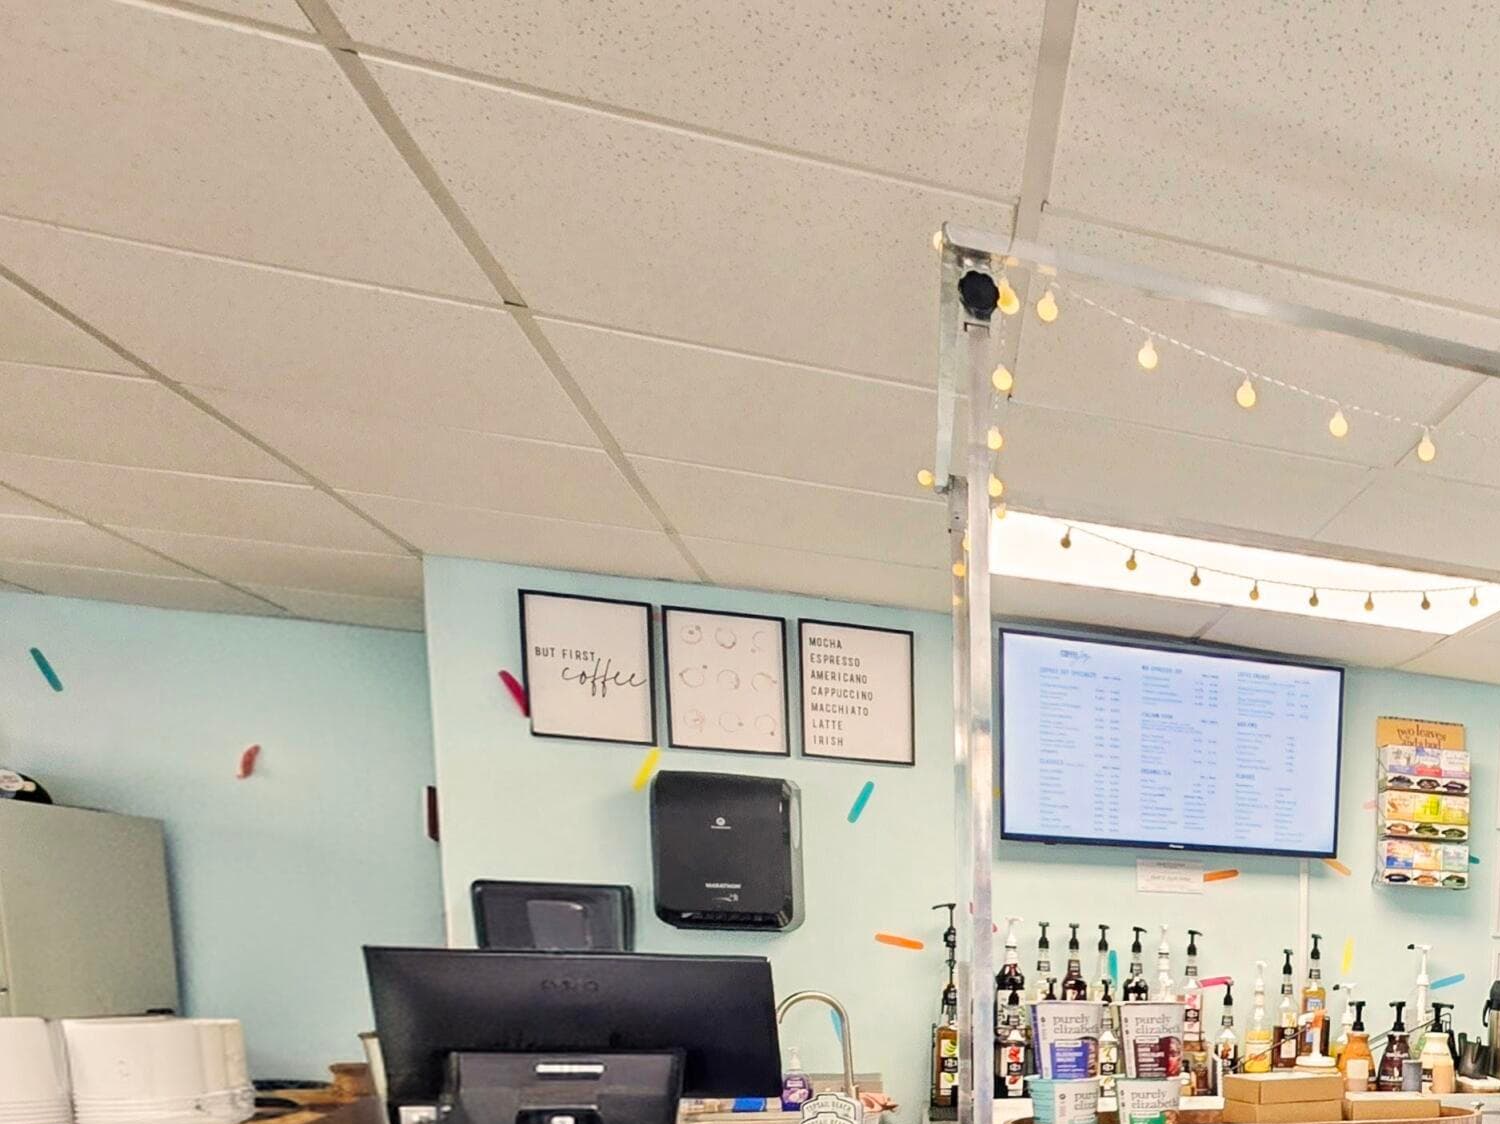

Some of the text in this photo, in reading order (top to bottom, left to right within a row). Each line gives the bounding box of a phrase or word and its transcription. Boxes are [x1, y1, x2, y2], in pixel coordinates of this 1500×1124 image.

[809, 637, 843, 650] MOCHA
[535, 646, 595, 662] BUT FIRST
[810, 653, 861, 668] ESPRESSO
[561, 658, 647, 697] coffee
[810, 670, 868, 685] AMERICANO
[810, 686, 874, 701] CAPPUCCINO
[811, 703, 869, 717] MACCHIATO
[812, 718, 844, 731] LATTE
[813, 734, 844, 747] IRISH
